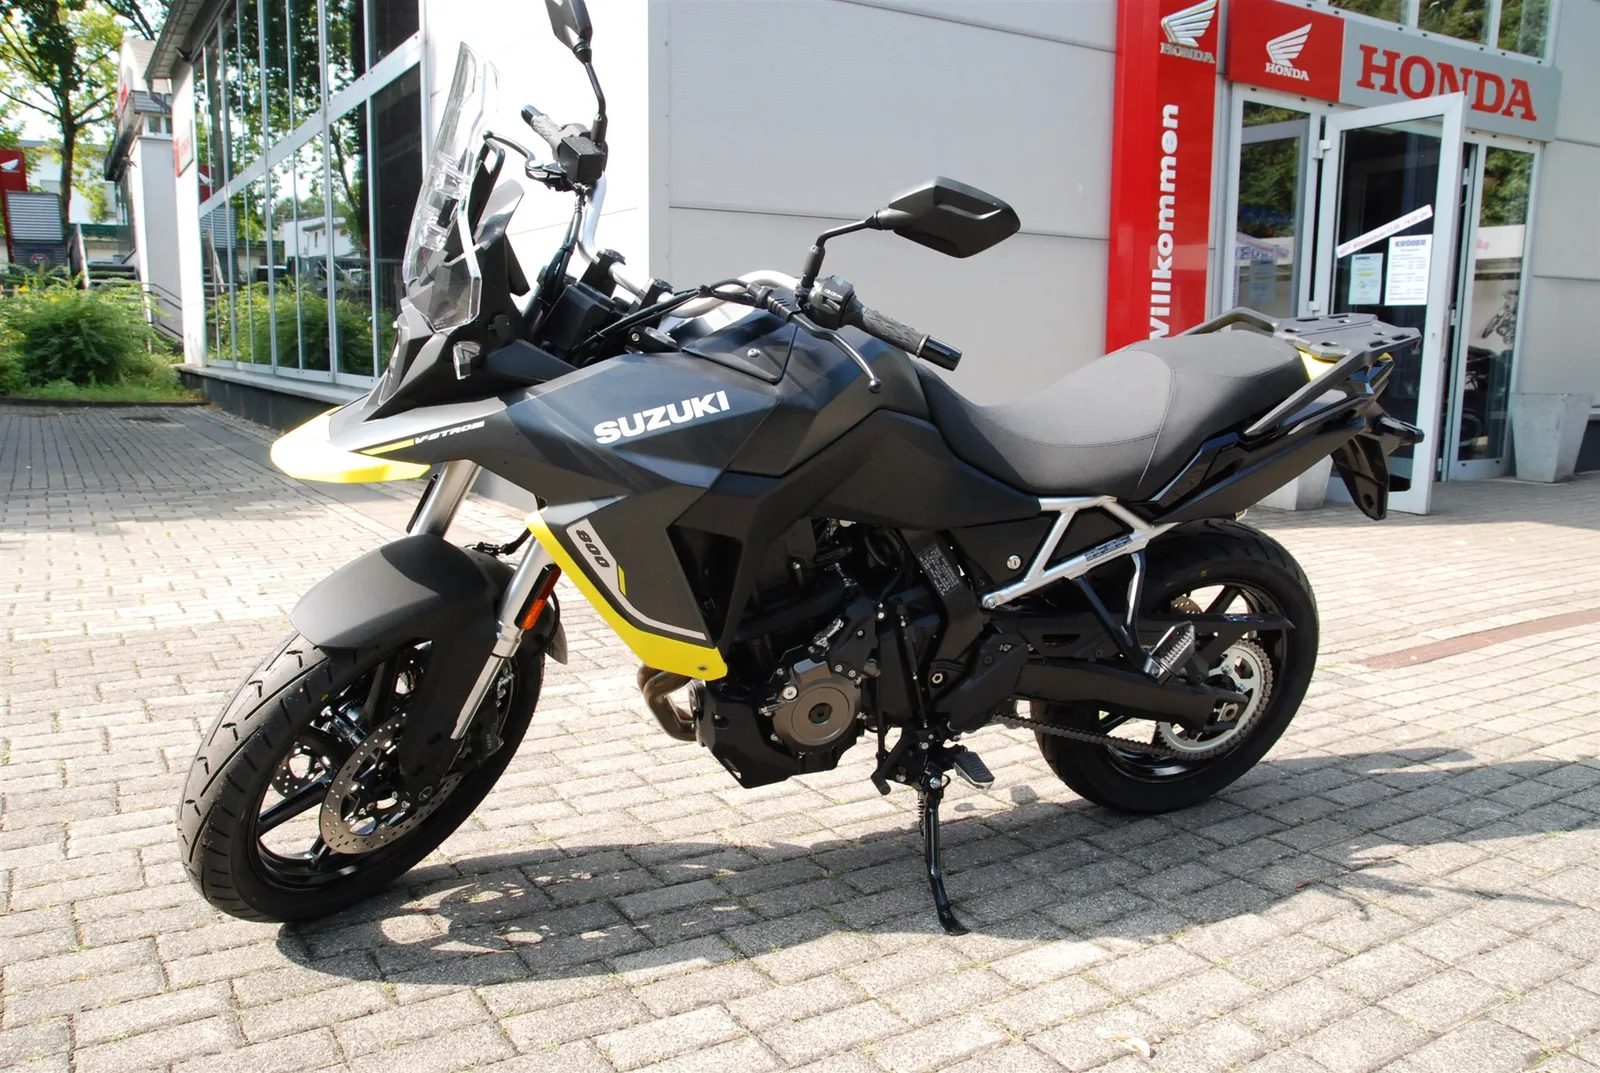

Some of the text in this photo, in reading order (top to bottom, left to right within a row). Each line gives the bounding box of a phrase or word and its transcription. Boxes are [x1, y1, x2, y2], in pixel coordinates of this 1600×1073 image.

[1160, 42, 1216, 64] HONDA
[1265, 62, 1310, 81] HONDA
[1356, 44, 1537, 122] HONDA
[415, 420, 485, 445] V-STROM
[593, 390, 731, 445] SUZUKI
[576, 529, 611, 569] 800
